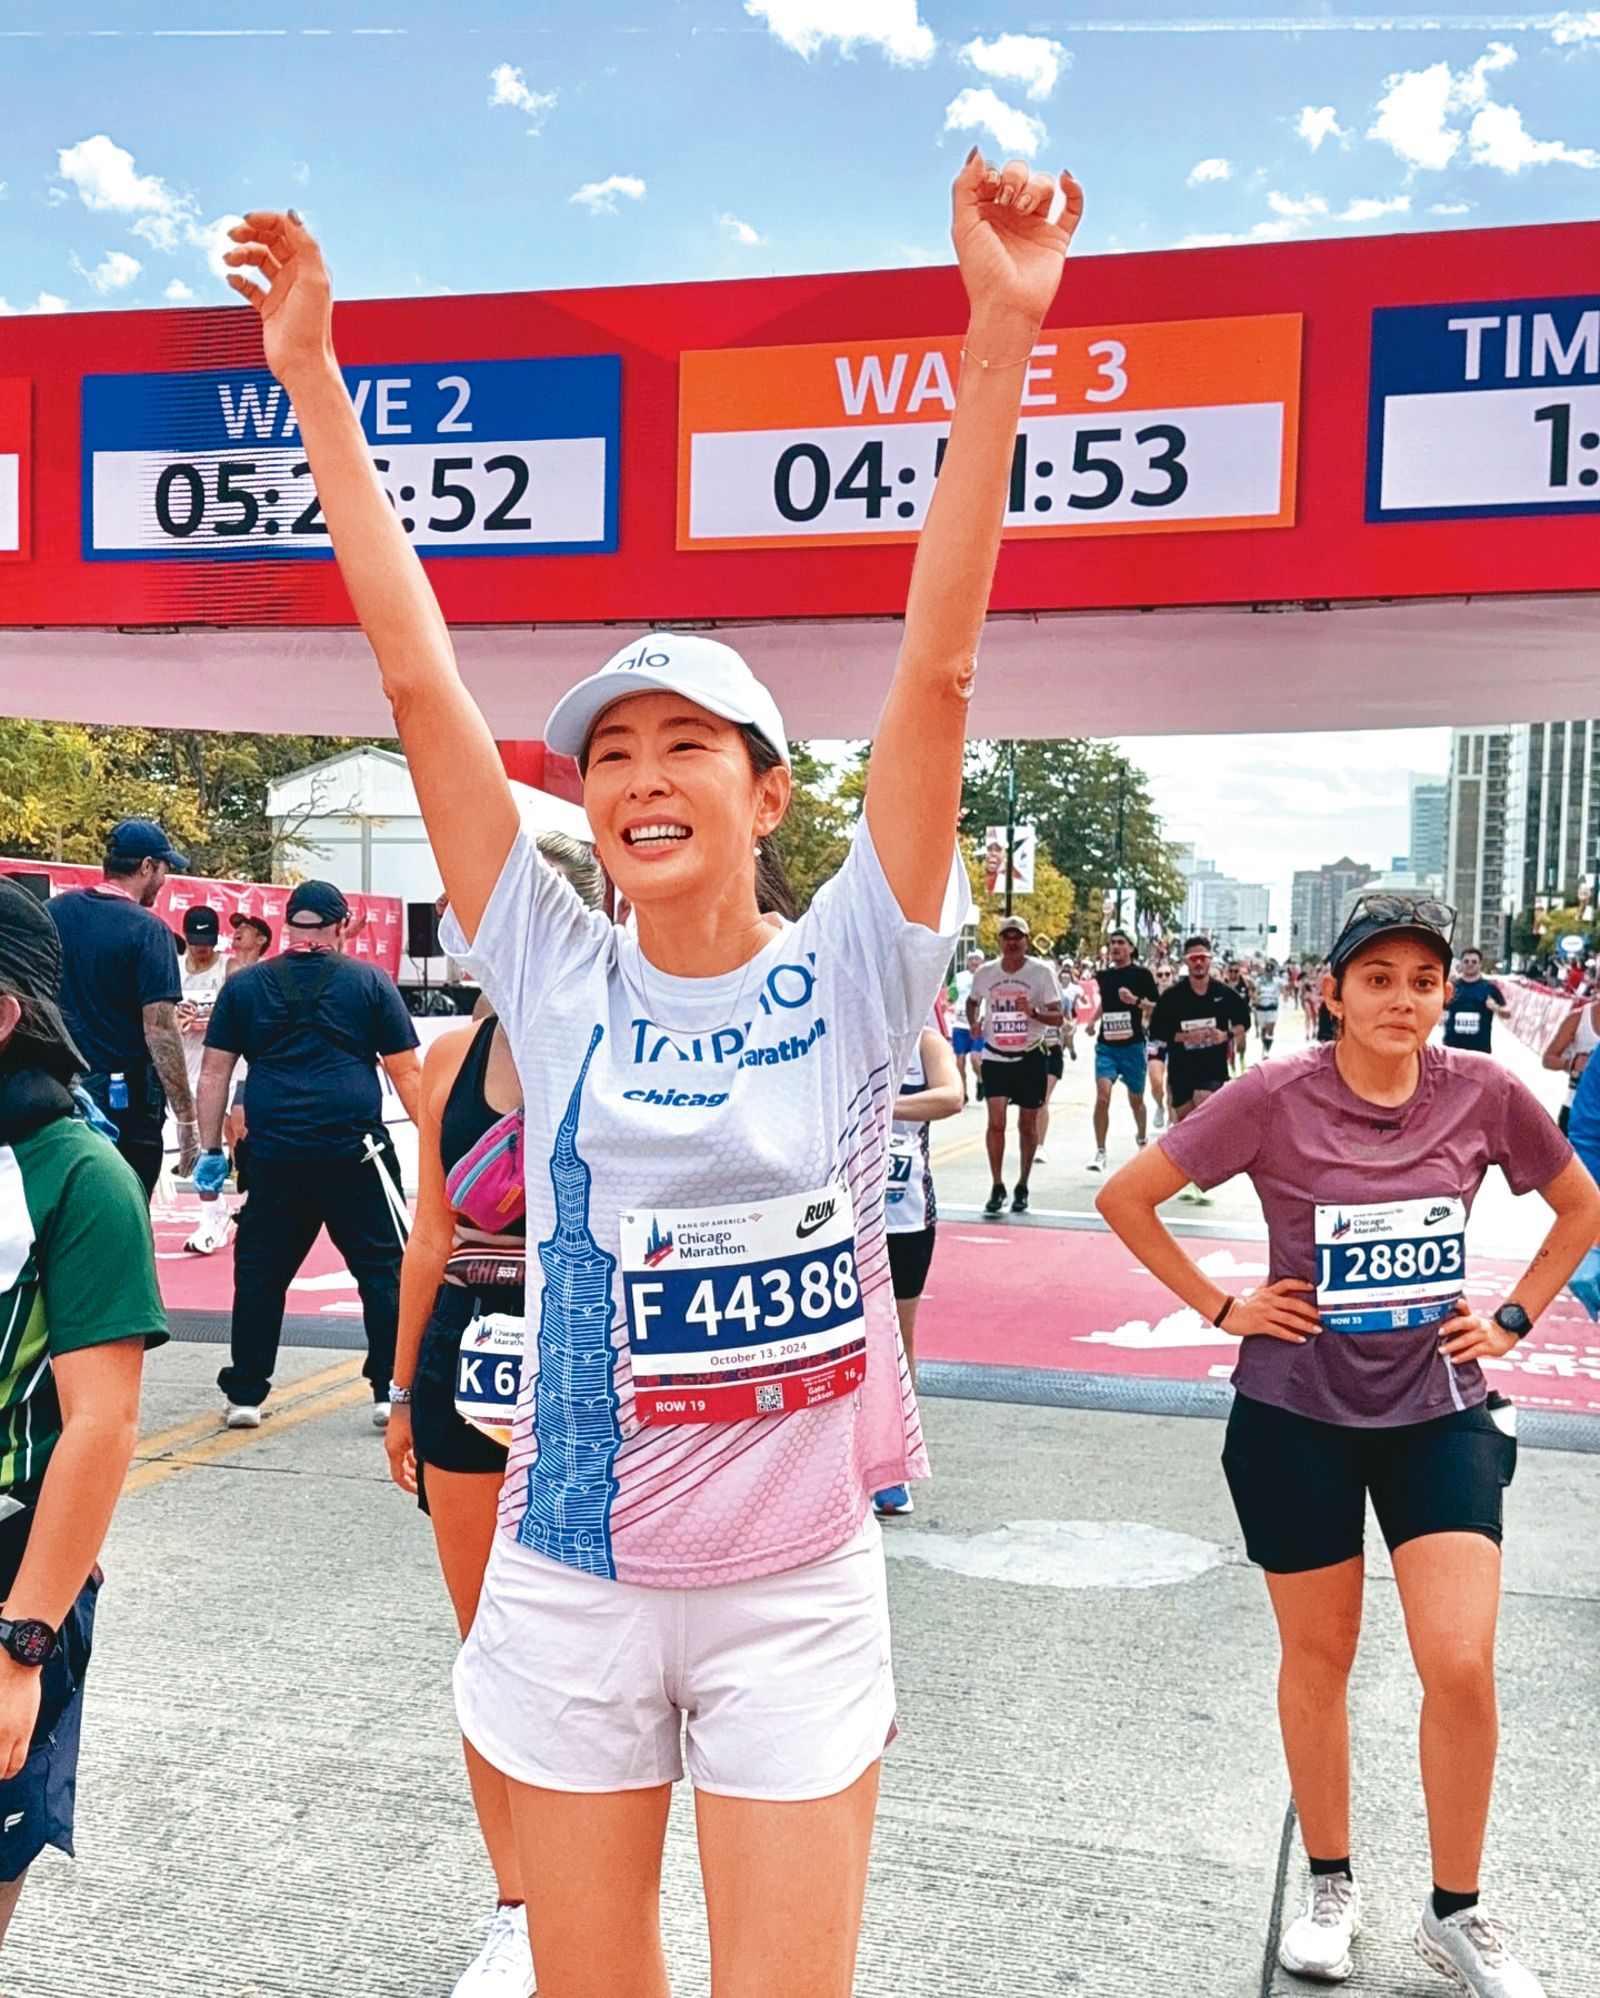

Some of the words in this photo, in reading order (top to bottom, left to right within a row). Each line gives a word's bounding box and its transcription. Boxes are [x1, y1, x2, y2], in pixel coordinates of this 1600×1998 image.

[834, 344, 1057, 416] WAE
[1085, 340, 1129, 403] 3
[436, 375, 473, 433] 2
[1534, 403, 1600, 487] 1:
[804, 1198, 836, 1223] RUN
[1429, 1205, 1451, 1217] RUN
[711, 1217, 747, 1227] AMERICA
[678, 1231, 732, 1247] Chicago
[679, 1243, 747, 1259] Marathon
[1317, 1249, 1331, 1292] J
[1345, 1239, 1461, 1282] 28803
[631, 1282, 664, 1340] F
[685, 1251, 858, 1336] 44388
[710, 1352, 757, 1367] October
[760, 1349, 777, 1361] 13,
[780, 1341, 808, 1356] 2024
[460, 1358, 483, 1394] K
[494, 1361, 522, 1396] 6
[844, 1368, 856, 1380] 16
[806, 1390, 835, 1405] Jackson
[808, 1385, 826, 1395] Gate
[656, 1401, 686, 1412] ROW
[690, 1400, 706, 1411] 19
